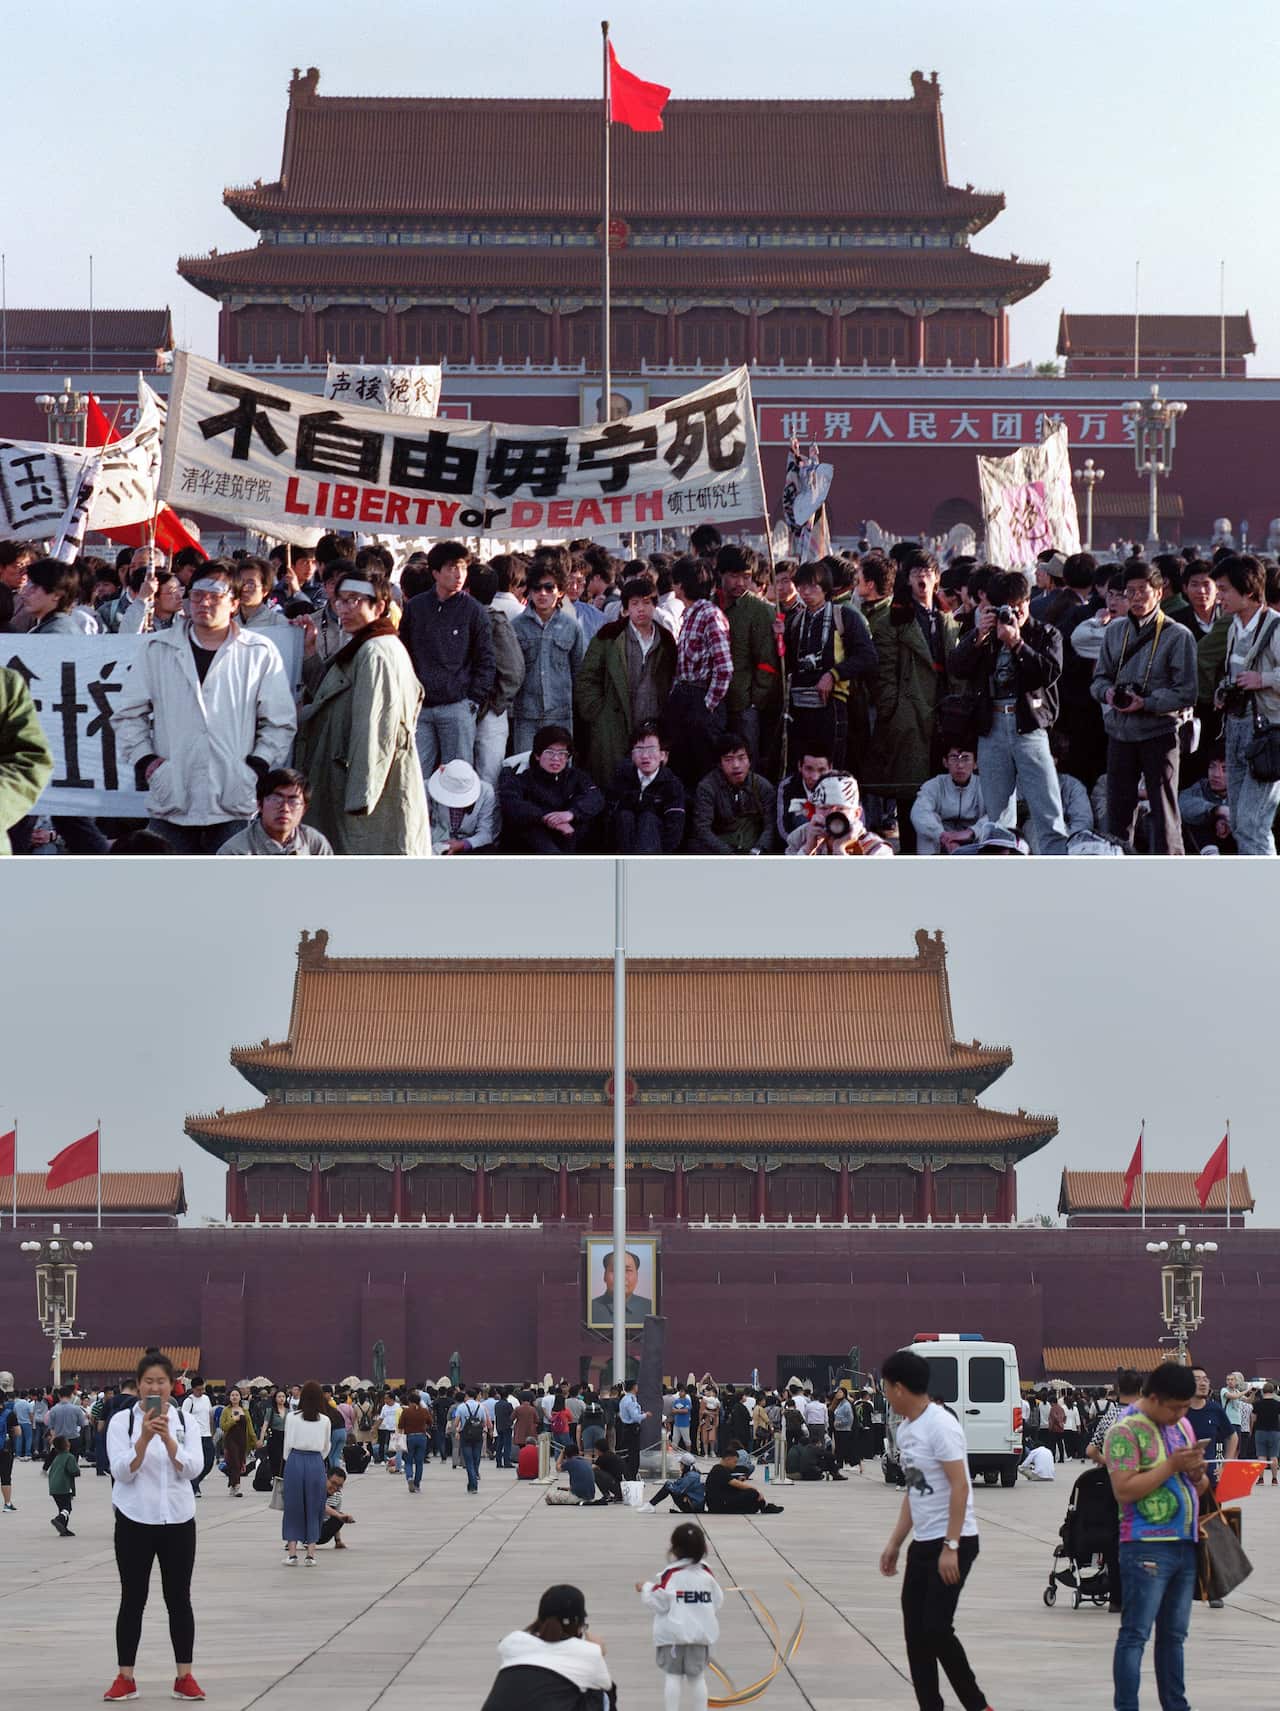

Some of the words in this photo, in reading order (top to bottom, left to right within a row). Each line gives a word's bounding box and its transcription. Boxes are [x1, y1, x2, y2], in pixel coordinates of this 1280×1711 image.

[181, 466, 273, 504] 清华建筑学院
[284, 476, 461, 528] LIBERTY
[459, 508, 507, 530] or
[511, 489, 665, 529] DEATH
[667, 480, 742, 515] 硕士研究生
